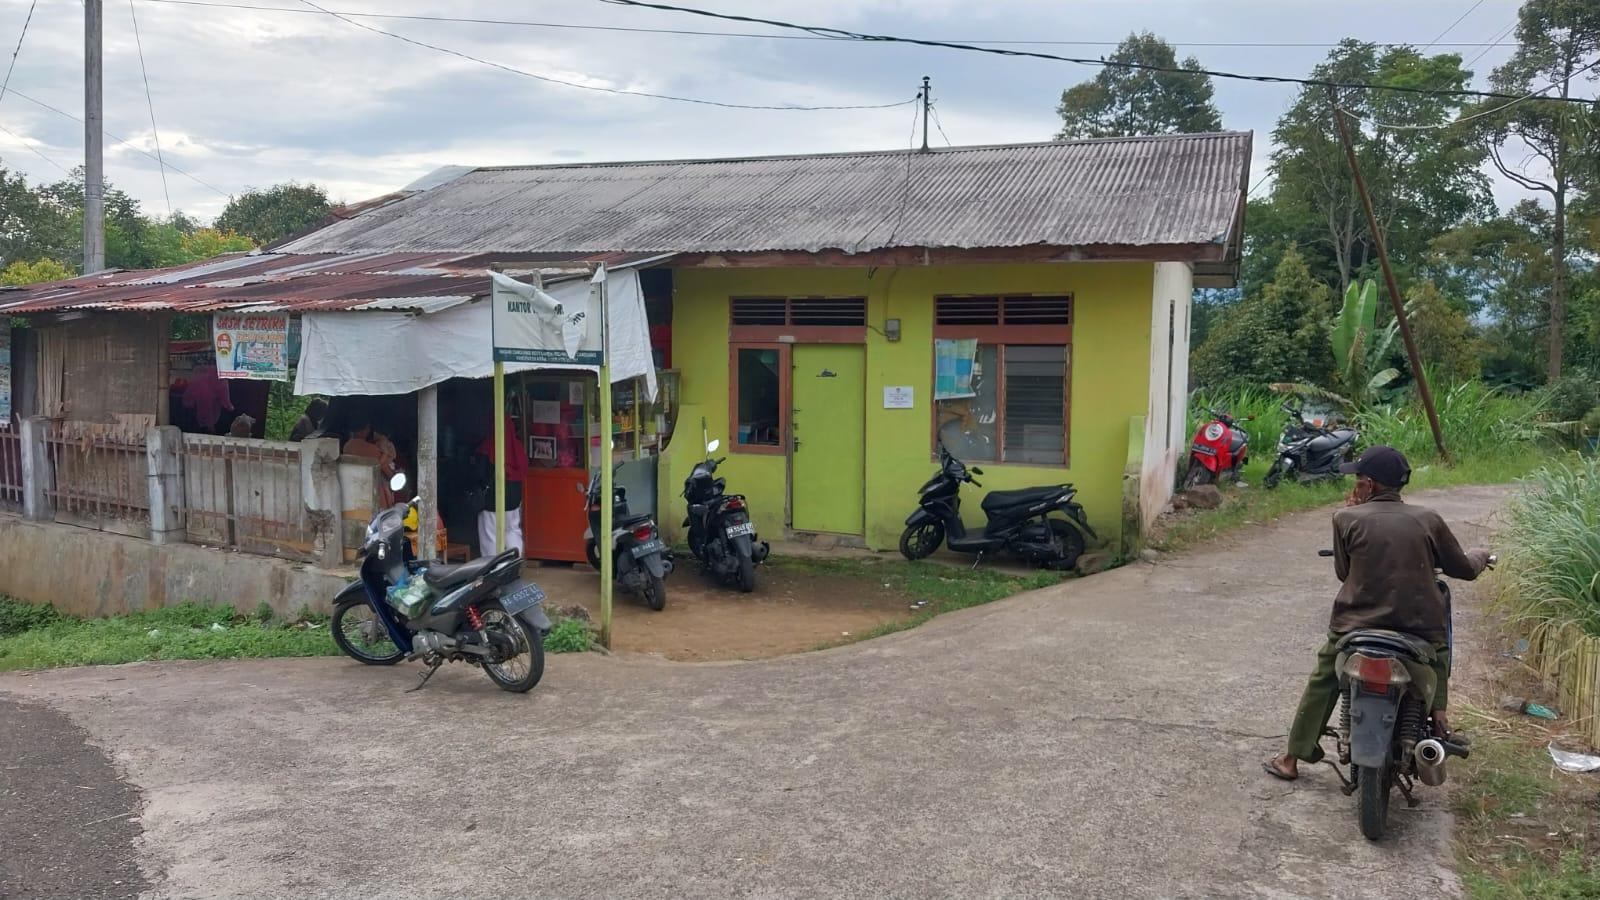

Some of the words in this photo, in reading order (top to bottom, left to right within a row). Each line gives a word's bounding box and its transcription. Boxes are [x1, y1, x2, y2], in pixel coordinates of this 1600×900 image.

[507, 300, 532, 314] KANTOR
[216, 315, 240, 330] JASA
[242, 314, 286, 331] SETRIKA
